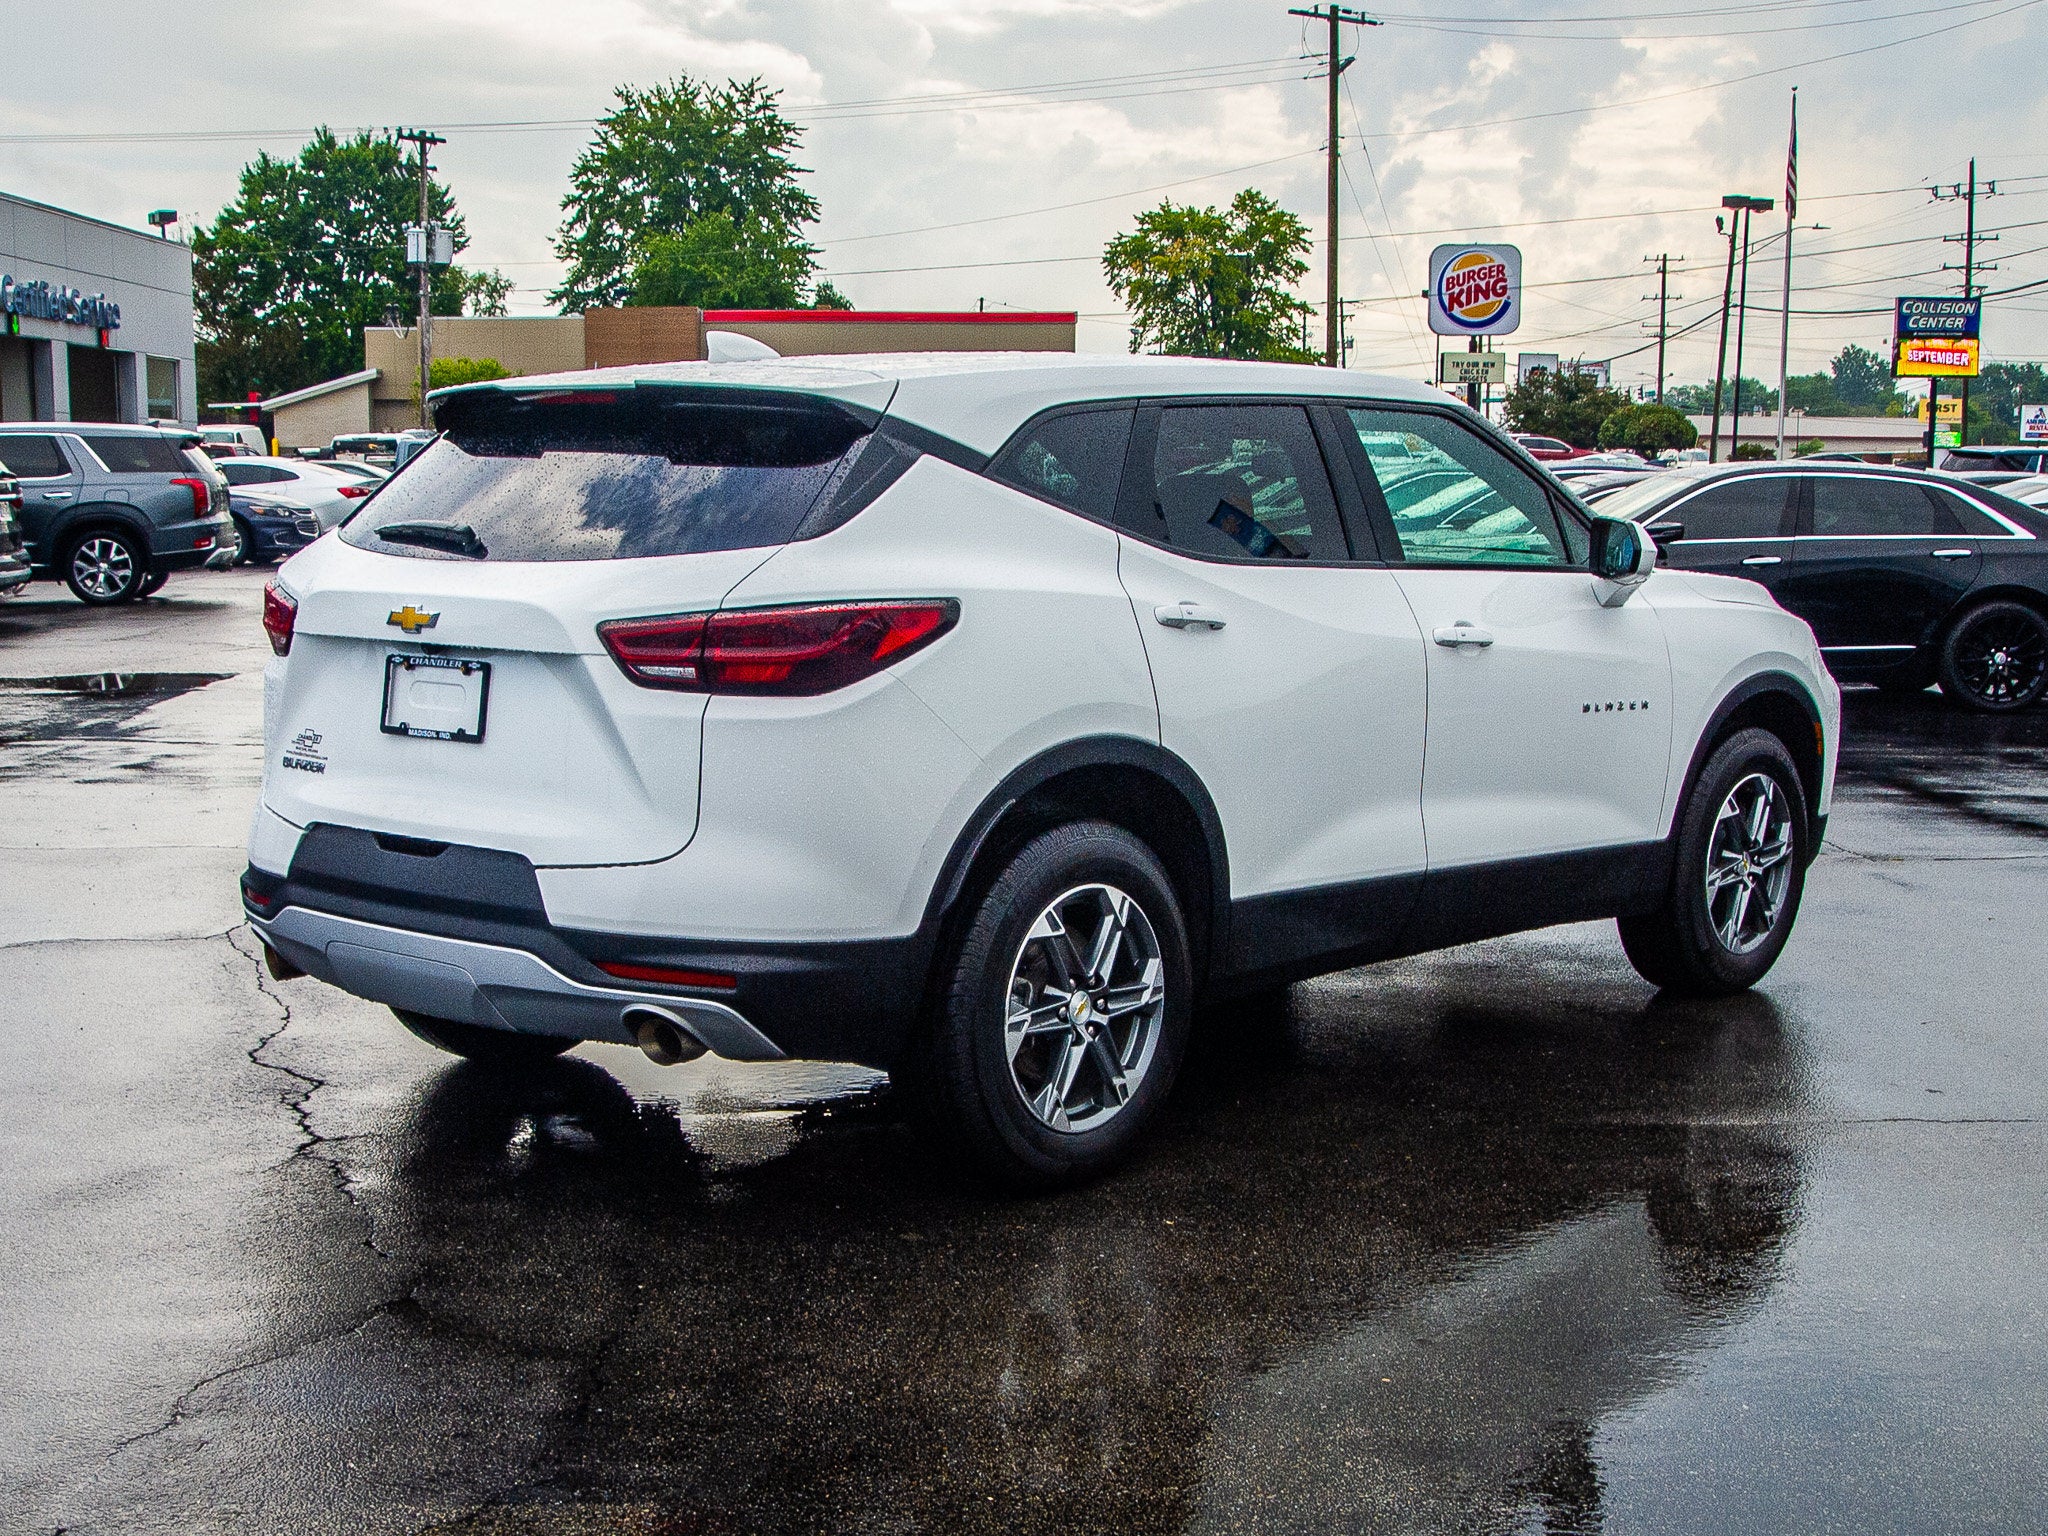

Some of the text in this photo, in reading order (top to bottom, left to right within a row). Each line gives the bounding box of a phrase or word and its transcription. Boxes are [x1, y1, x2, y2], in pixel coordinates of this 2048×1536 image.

[1445, 263, 1506, 293] BURGER
[2, 275, 120, 330] Certified Service
[1447, 277, 1508, 313] KING
[1902, 300, 1977, 315] COLLISION
[1908, 315, 1966, 329] CENTER
[1907, 349, 1970, 366] SEPTEMBER
[410, 657, 463, 668] CHANDLER
[1582, 700, 1649, 714] BLAZER
